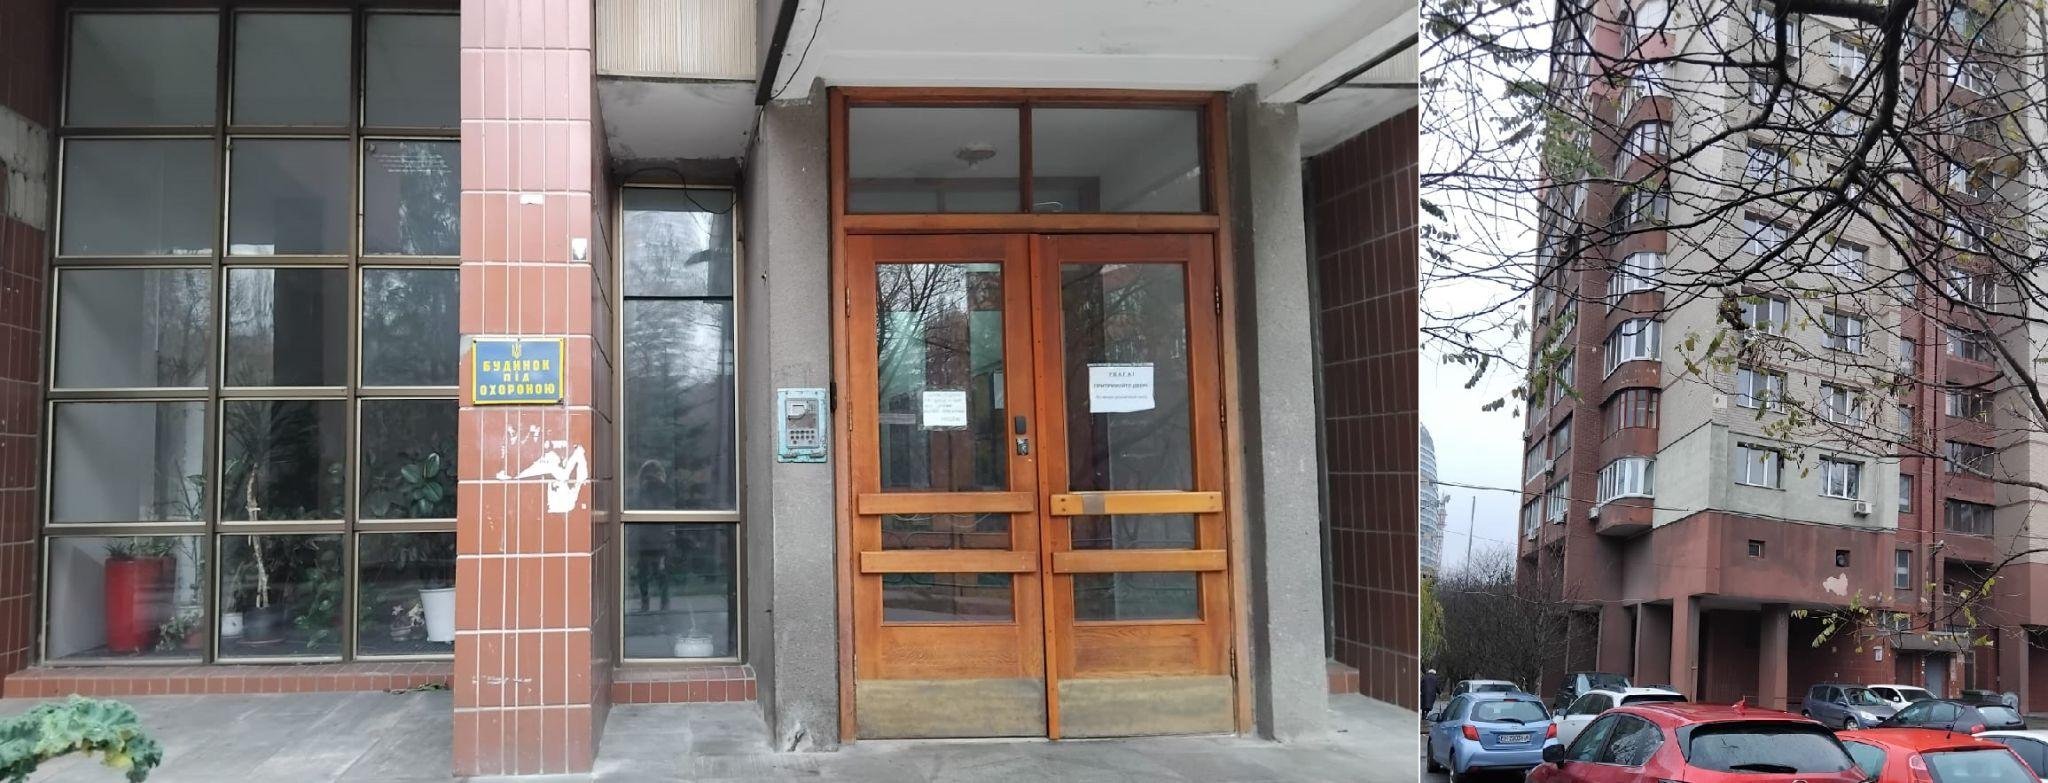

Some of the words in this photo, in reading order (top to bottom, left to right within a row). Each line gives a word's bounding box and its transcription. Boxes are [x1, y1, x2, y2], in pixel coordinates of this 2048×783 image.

[483, 360, 550, 372] БУДИНОК
[503, 372, 530, 382] ПІД
[480, 383, 555, 396] ОХОРОНОЮ
